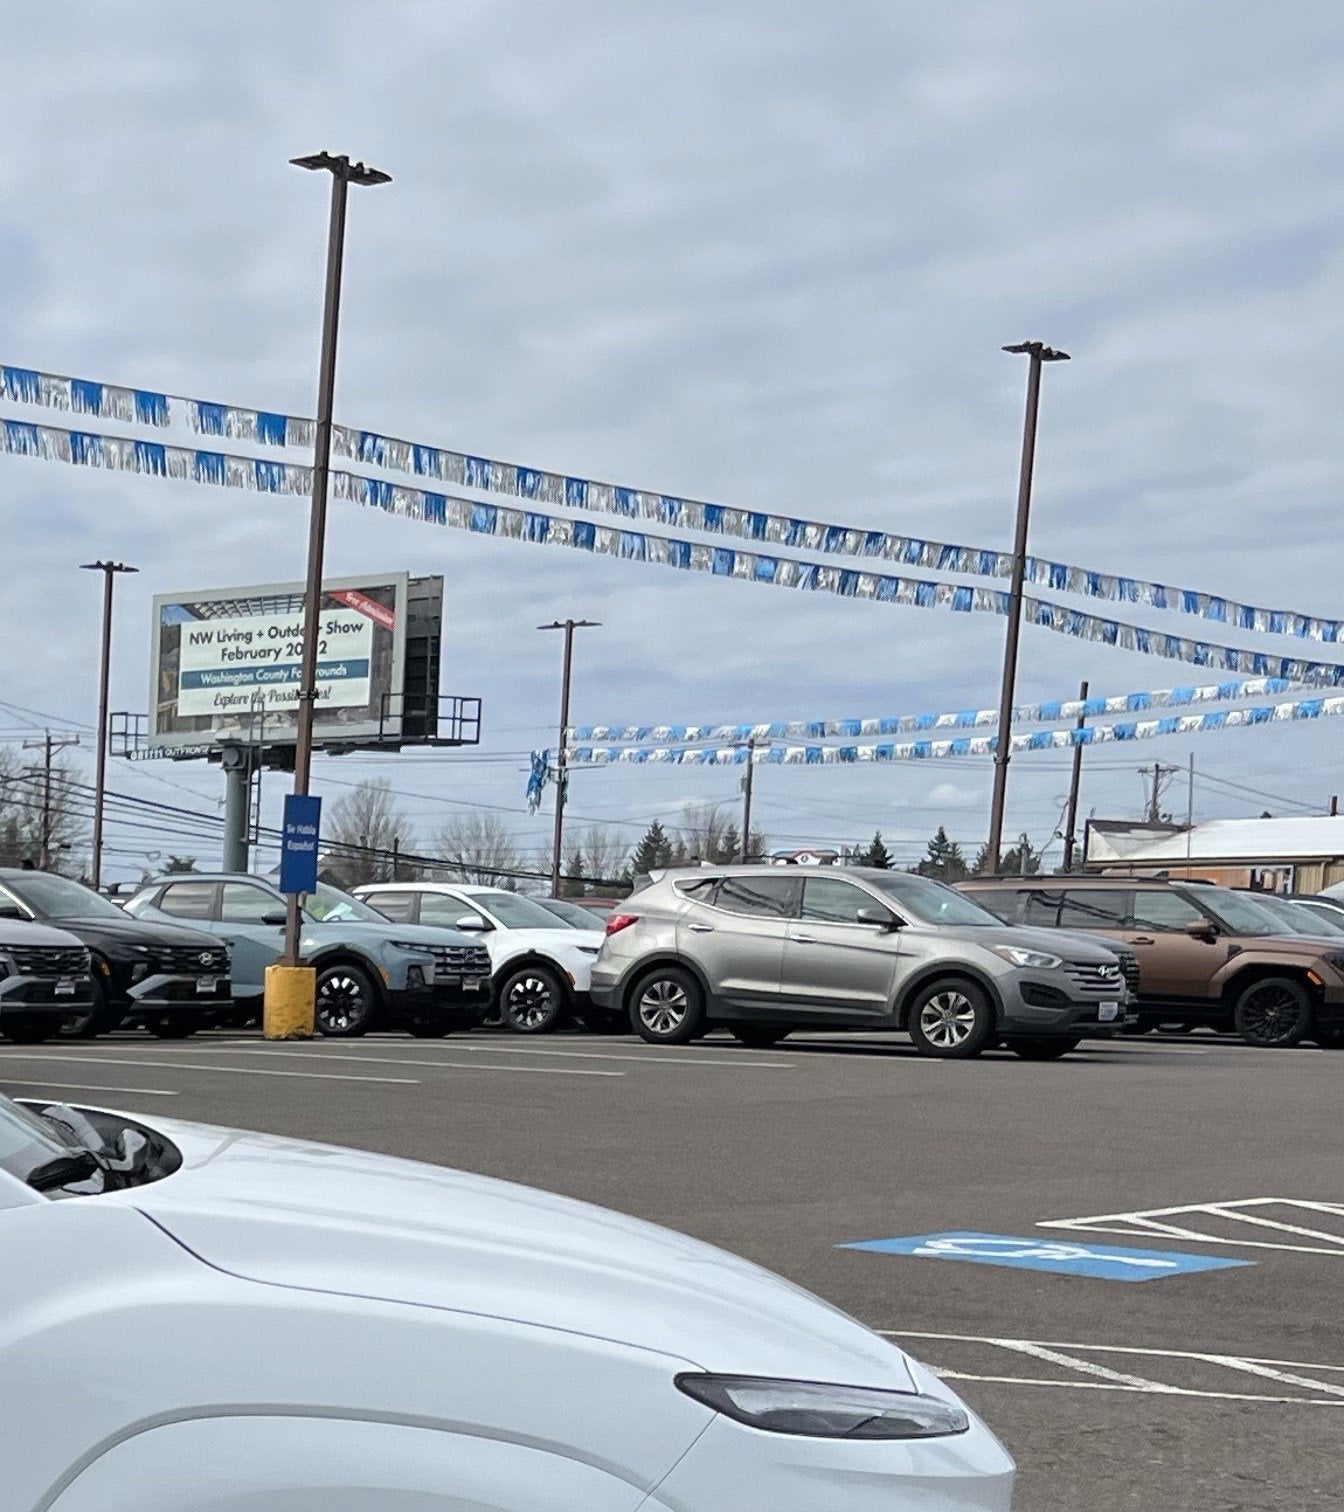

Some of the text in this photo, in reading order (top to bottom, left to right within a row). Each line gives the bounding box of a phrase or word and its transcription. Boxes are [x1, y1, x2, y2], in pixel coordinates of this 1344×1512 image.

[190, 631, 213, 645] NW
[217, 628, 253, 645] Living
[326, 620, 364, 635] Show
[222, 645, 281, 662] February
[201, 670, 254, 685] Washington
[256, 667, 290, 682] County
[214, 692, 249, 709] Explore
